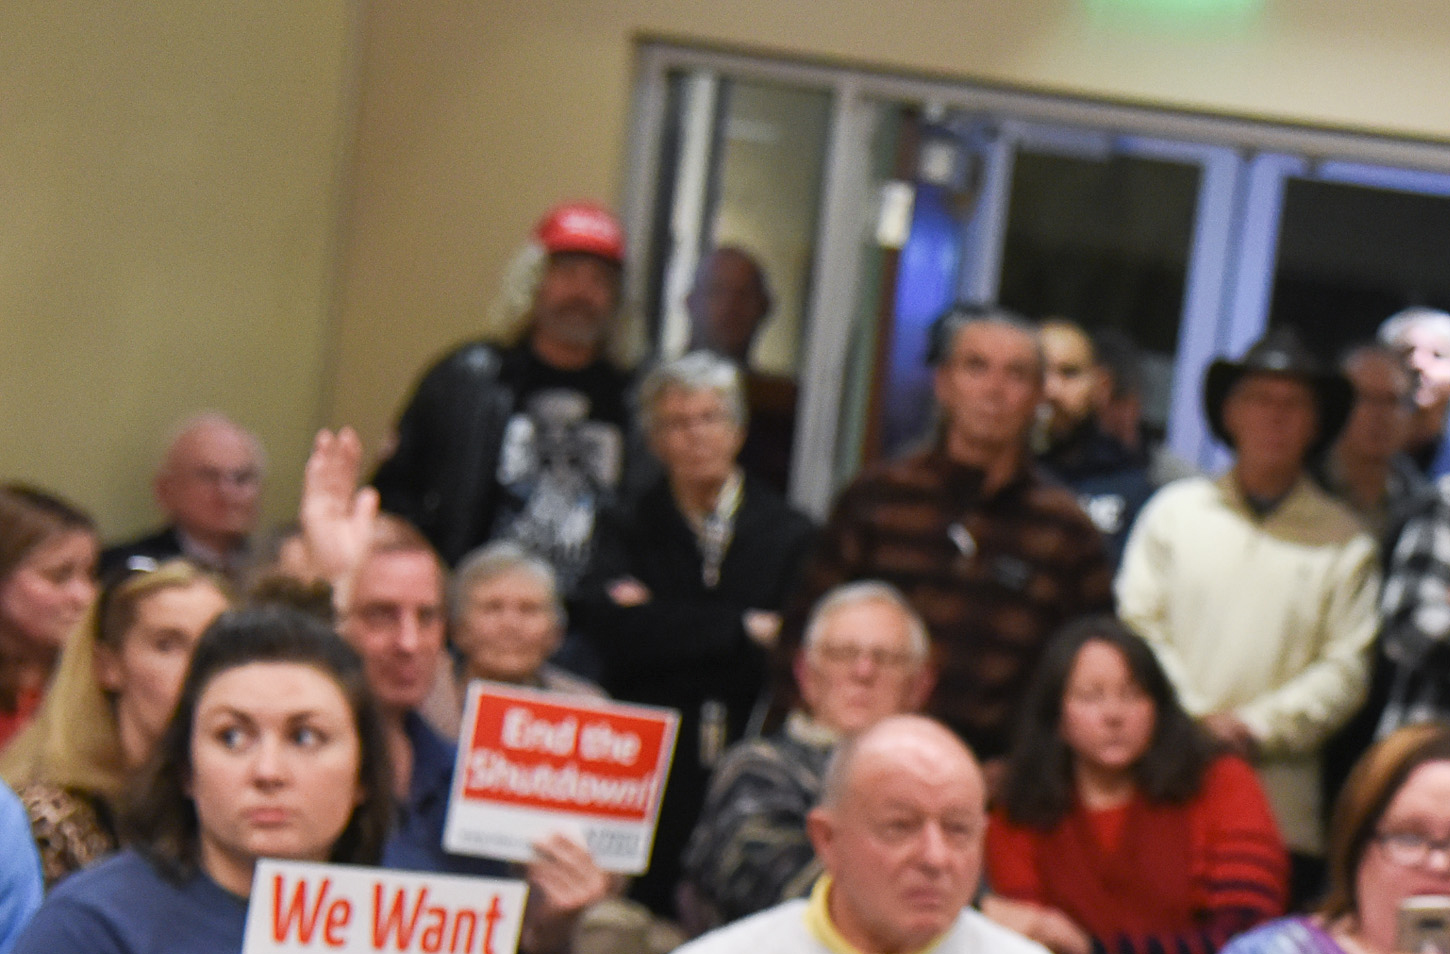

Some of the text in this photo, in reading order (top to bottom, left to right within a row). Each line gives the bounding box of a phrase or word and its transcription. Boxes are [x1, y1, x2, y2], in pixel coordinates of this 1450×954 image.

[502, 706, 643, 768] End the
[272, 873, 351, 948] We
